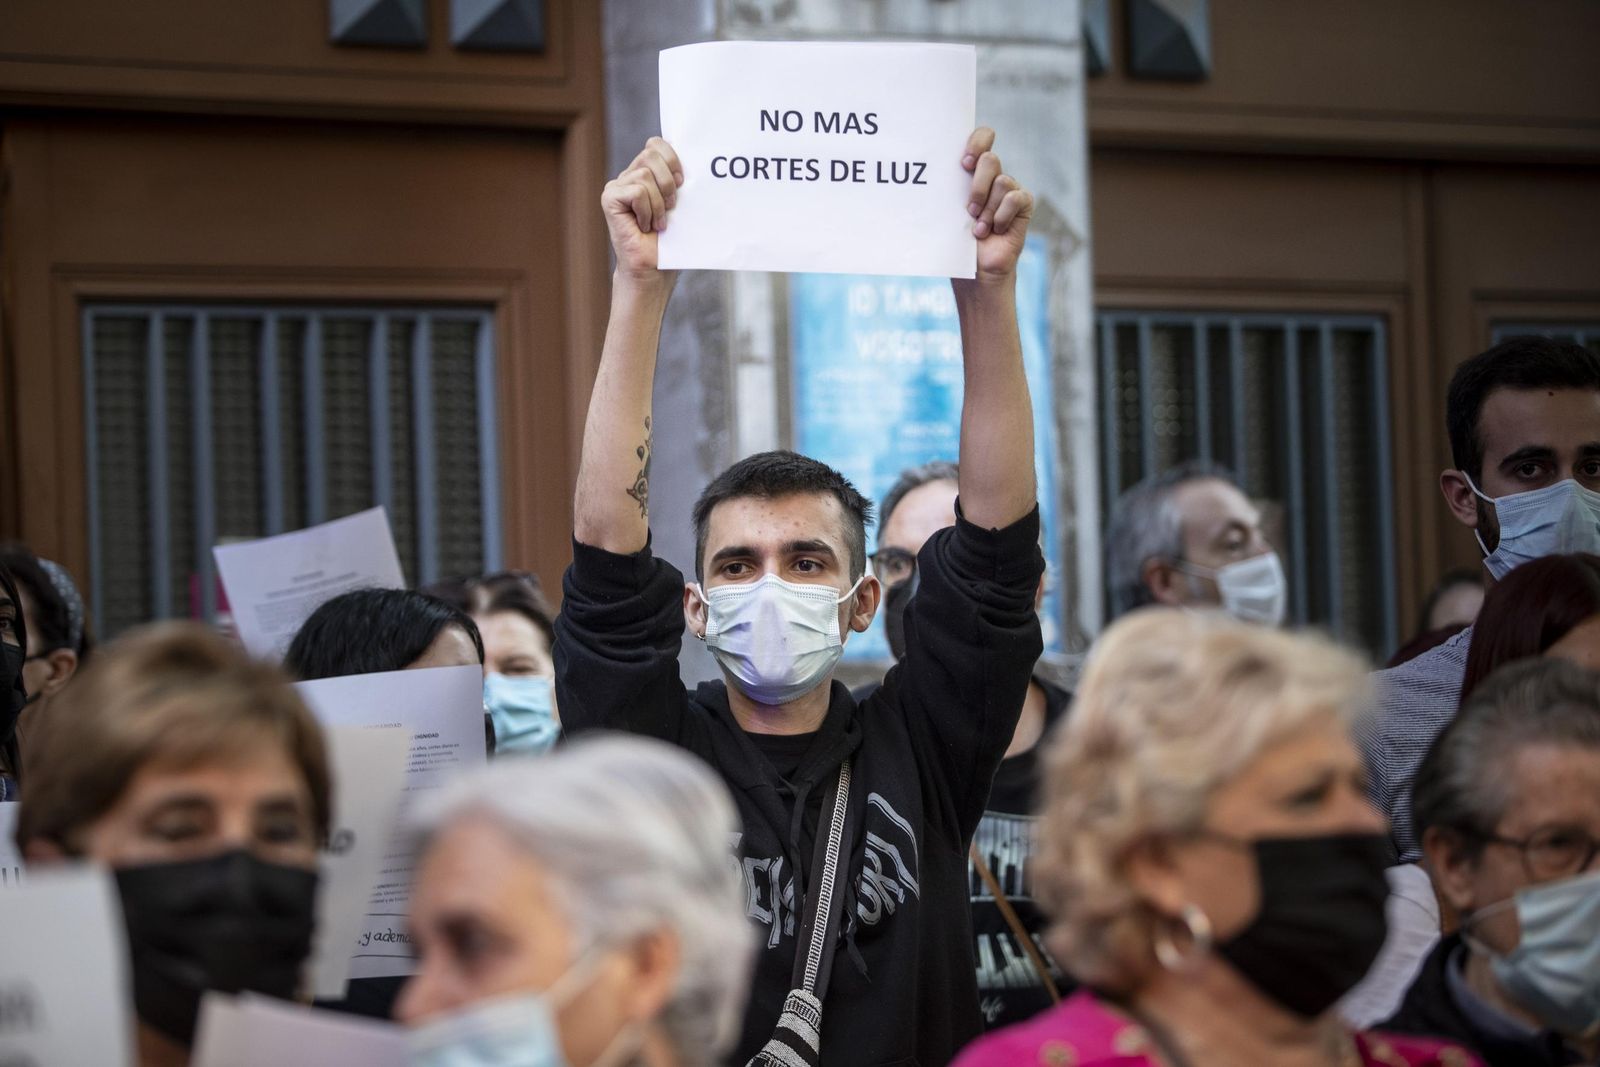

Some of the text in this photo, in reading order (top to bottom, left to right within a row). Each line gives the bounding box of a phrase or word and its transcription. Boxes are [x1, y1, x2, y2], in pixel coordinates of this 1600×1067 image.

[760, 109, 879, 135] NO MAS
[710, 155, 928, 185] CORTES DE LUZ
